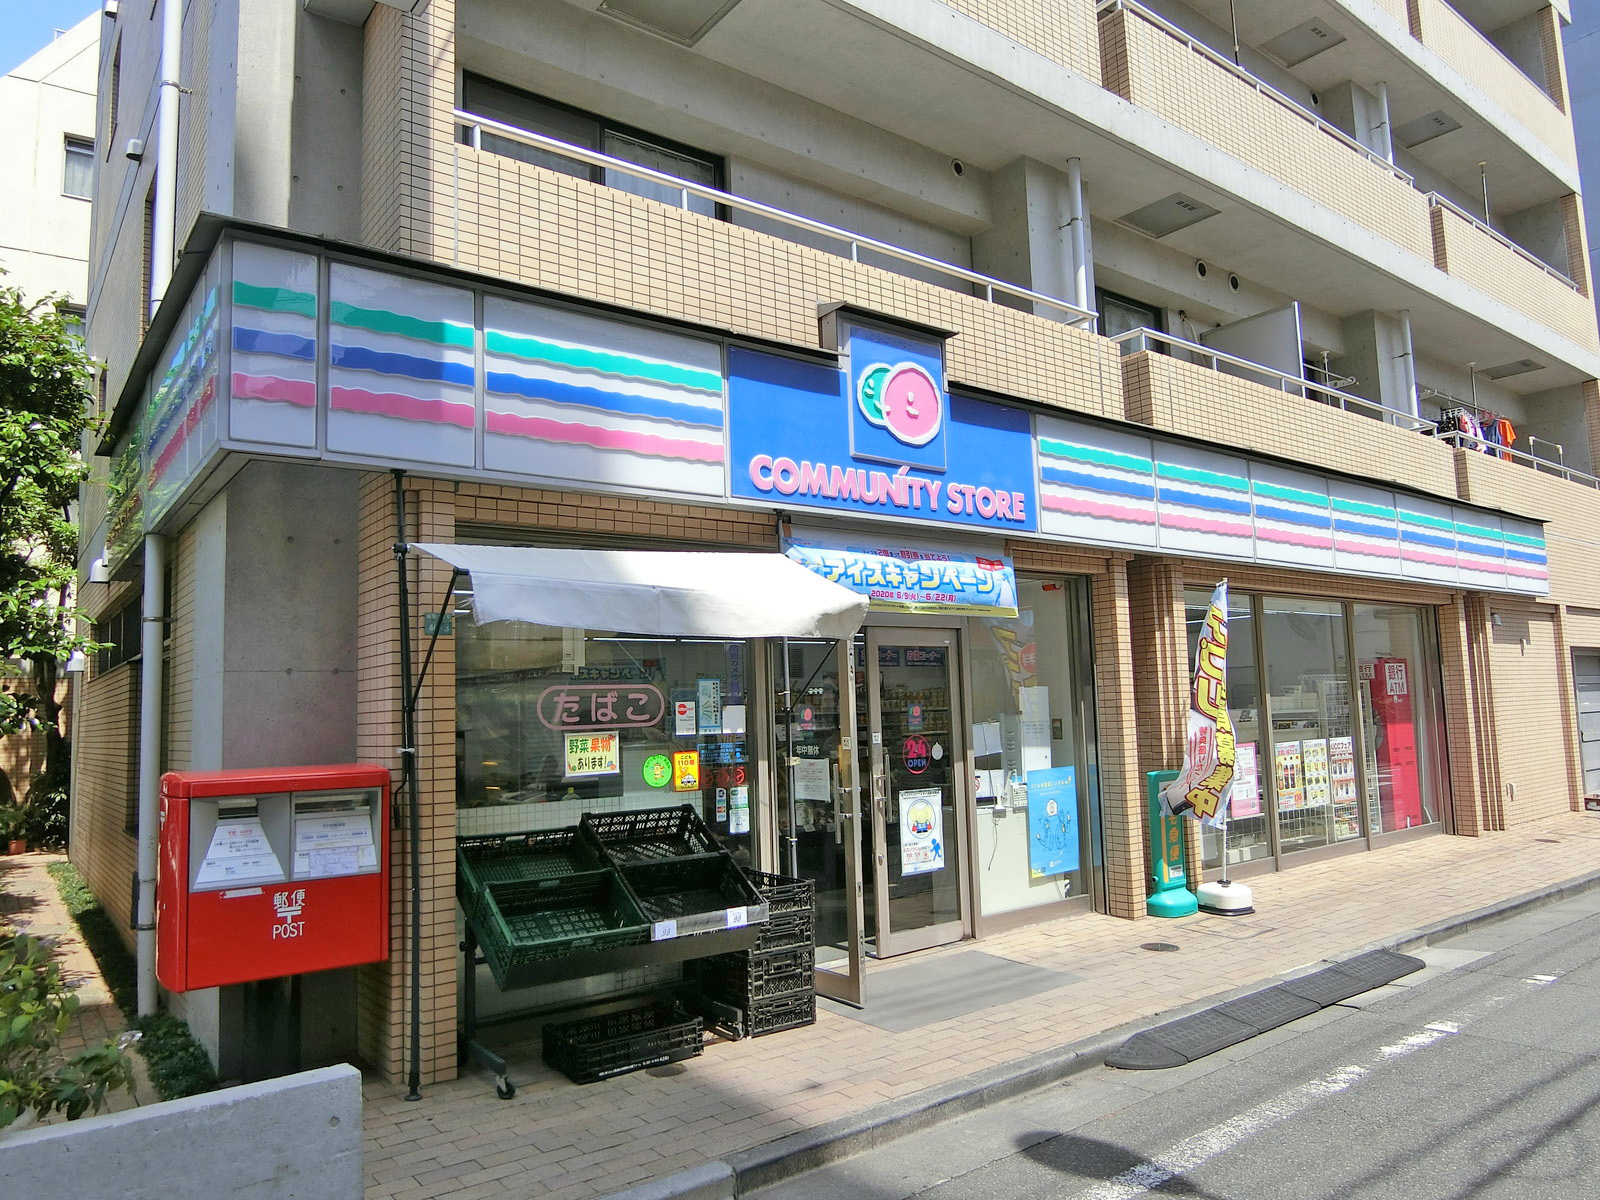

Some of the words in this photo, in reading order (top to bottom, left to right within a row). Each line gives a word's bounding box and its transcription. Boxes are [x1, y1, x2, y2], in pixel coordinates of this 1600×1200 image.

[947, 482, 1026, 521] STORE
[820, 557, 995, 594] アイスキャンペーン
[1388, 665, 1403, 680] 銀行
[1389, 682, 1405, 693] ATM
[553, 690, 650, 723] たばこ
[906, 740, 927, 758] 24
[577, 755, 607, 771] あります!
[908, 759, 927, 767] OPEN
[273, 889, 305, 909] 郵便
[273, 921, 305, 939] POST
